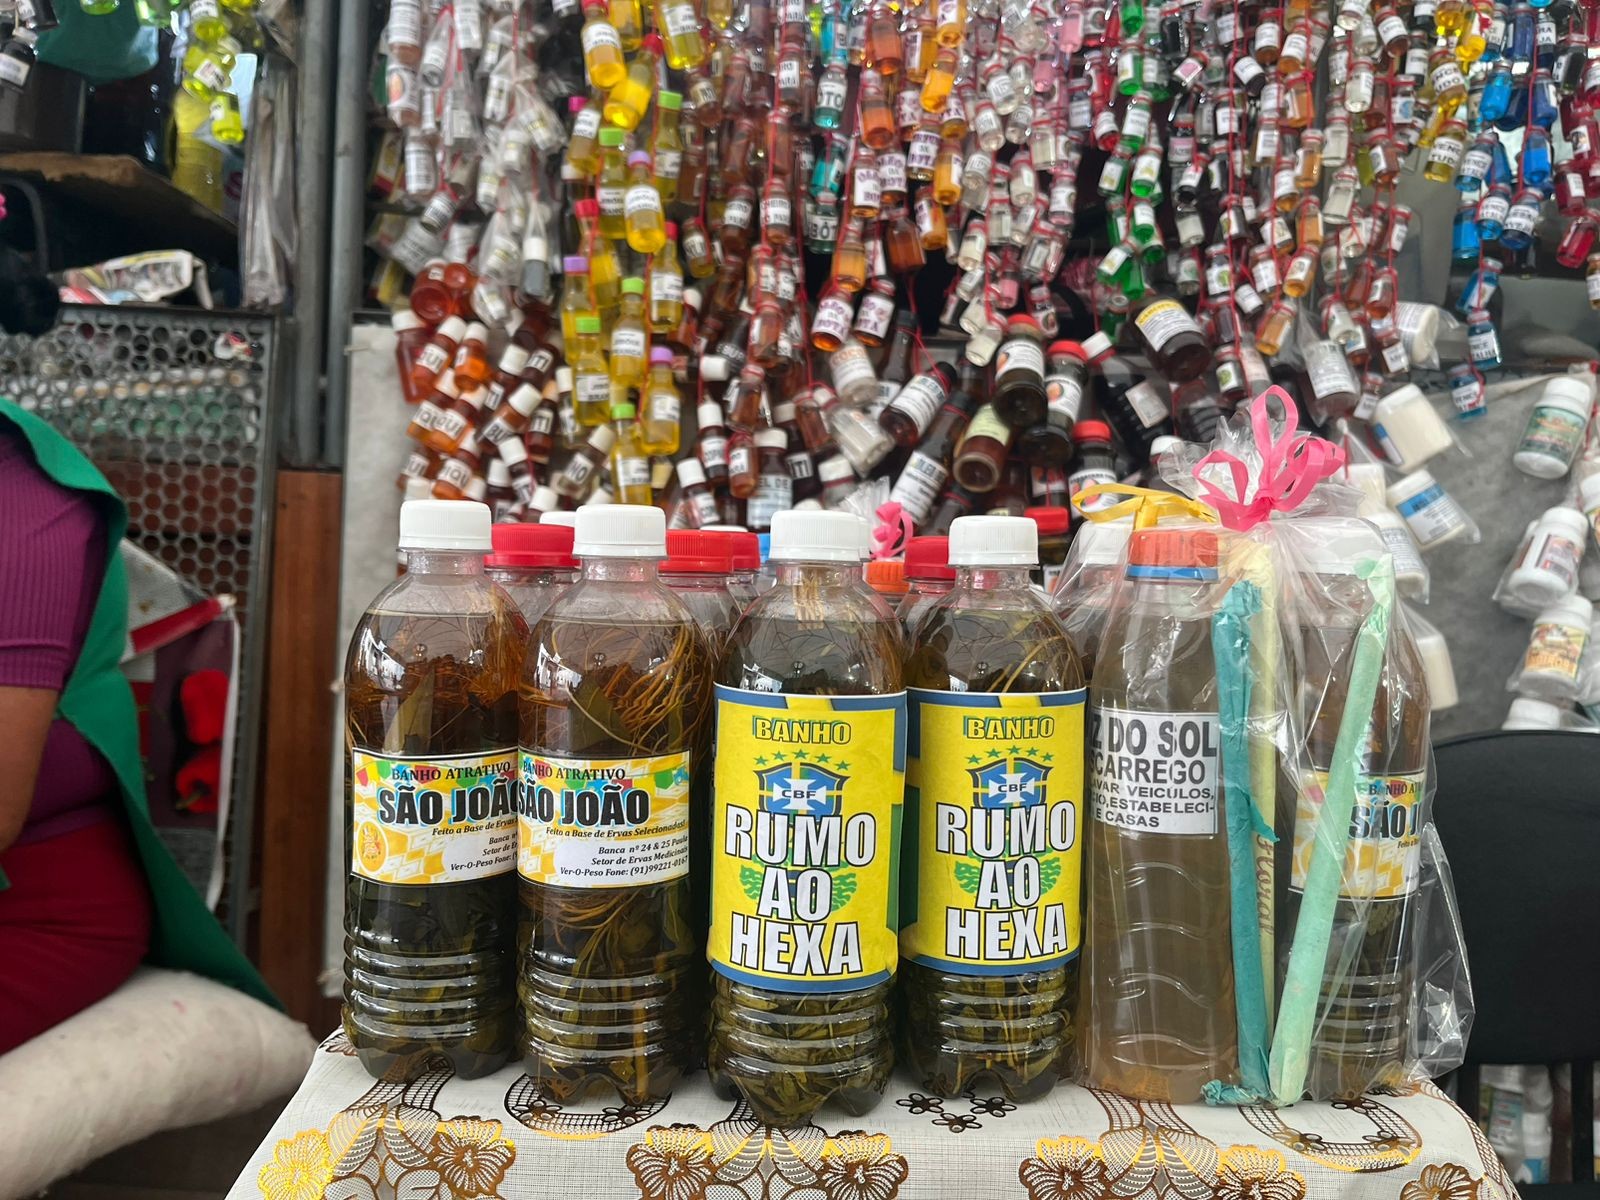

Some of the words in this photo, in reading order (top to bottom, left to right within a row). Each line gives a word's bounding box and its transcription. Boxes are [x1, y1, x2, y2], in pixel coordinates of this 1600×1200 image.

[753, 716, 851, 745] BANHO
[964, 715, 1054, 740] BANHO
[1108, 717, 1147, 755] DO
[1158, 719, 1218, 758] SOL
[392, 768, 441, 781] BANHO
[445, 761, 511, 779] ATRATIVO
[523, 761, 553, 779] BANHO
[556, 767, 625, 780] ATRATIVO
[781, 789, 816, 799] CBF
[997, 783, 1028, 793] CBF
[379, 784, 444, 825] SÃO
[517, 774, 554, 823] SÃO
[561, 783, 650, 827] JOÃO
[1105, 811, 1160, 828] CASAS
[432, 827, 454, 836] Feito
[464, 825, 483, 833] Base
[546, 827, 564, 836] Feito
[572, 829, 593, 838] Base
[607, 829, 633, 838] Ervas
[725, 803, 877, 868] RUMO
[936, 801, 1076, 859] RUMO
[489, 835, 510, 845] Banca
[598, 847, 626, 855] Banca
[641, 844, 652, 852] 24
[661, 840, 671, 849] 25
[482, 847, 502, 856] Setor
[503, 844, 510, 852] de
[450, 858, 494, 871] Ver-O-Peso
[591, 858, 614, 866] Setor
[618, 856, 627, 864] de
[629, 855, 652, 864] Ervas
[560, 867, 604, 876] Ver-O-Peso
[605, 867, 629, 876] Fone:
[976, 855, 1041, 909] AO
[757, 866, 833, 922] AO
[945, 903, 1068, 961] HEXA
[730, 912, 863, 976] HEXA
